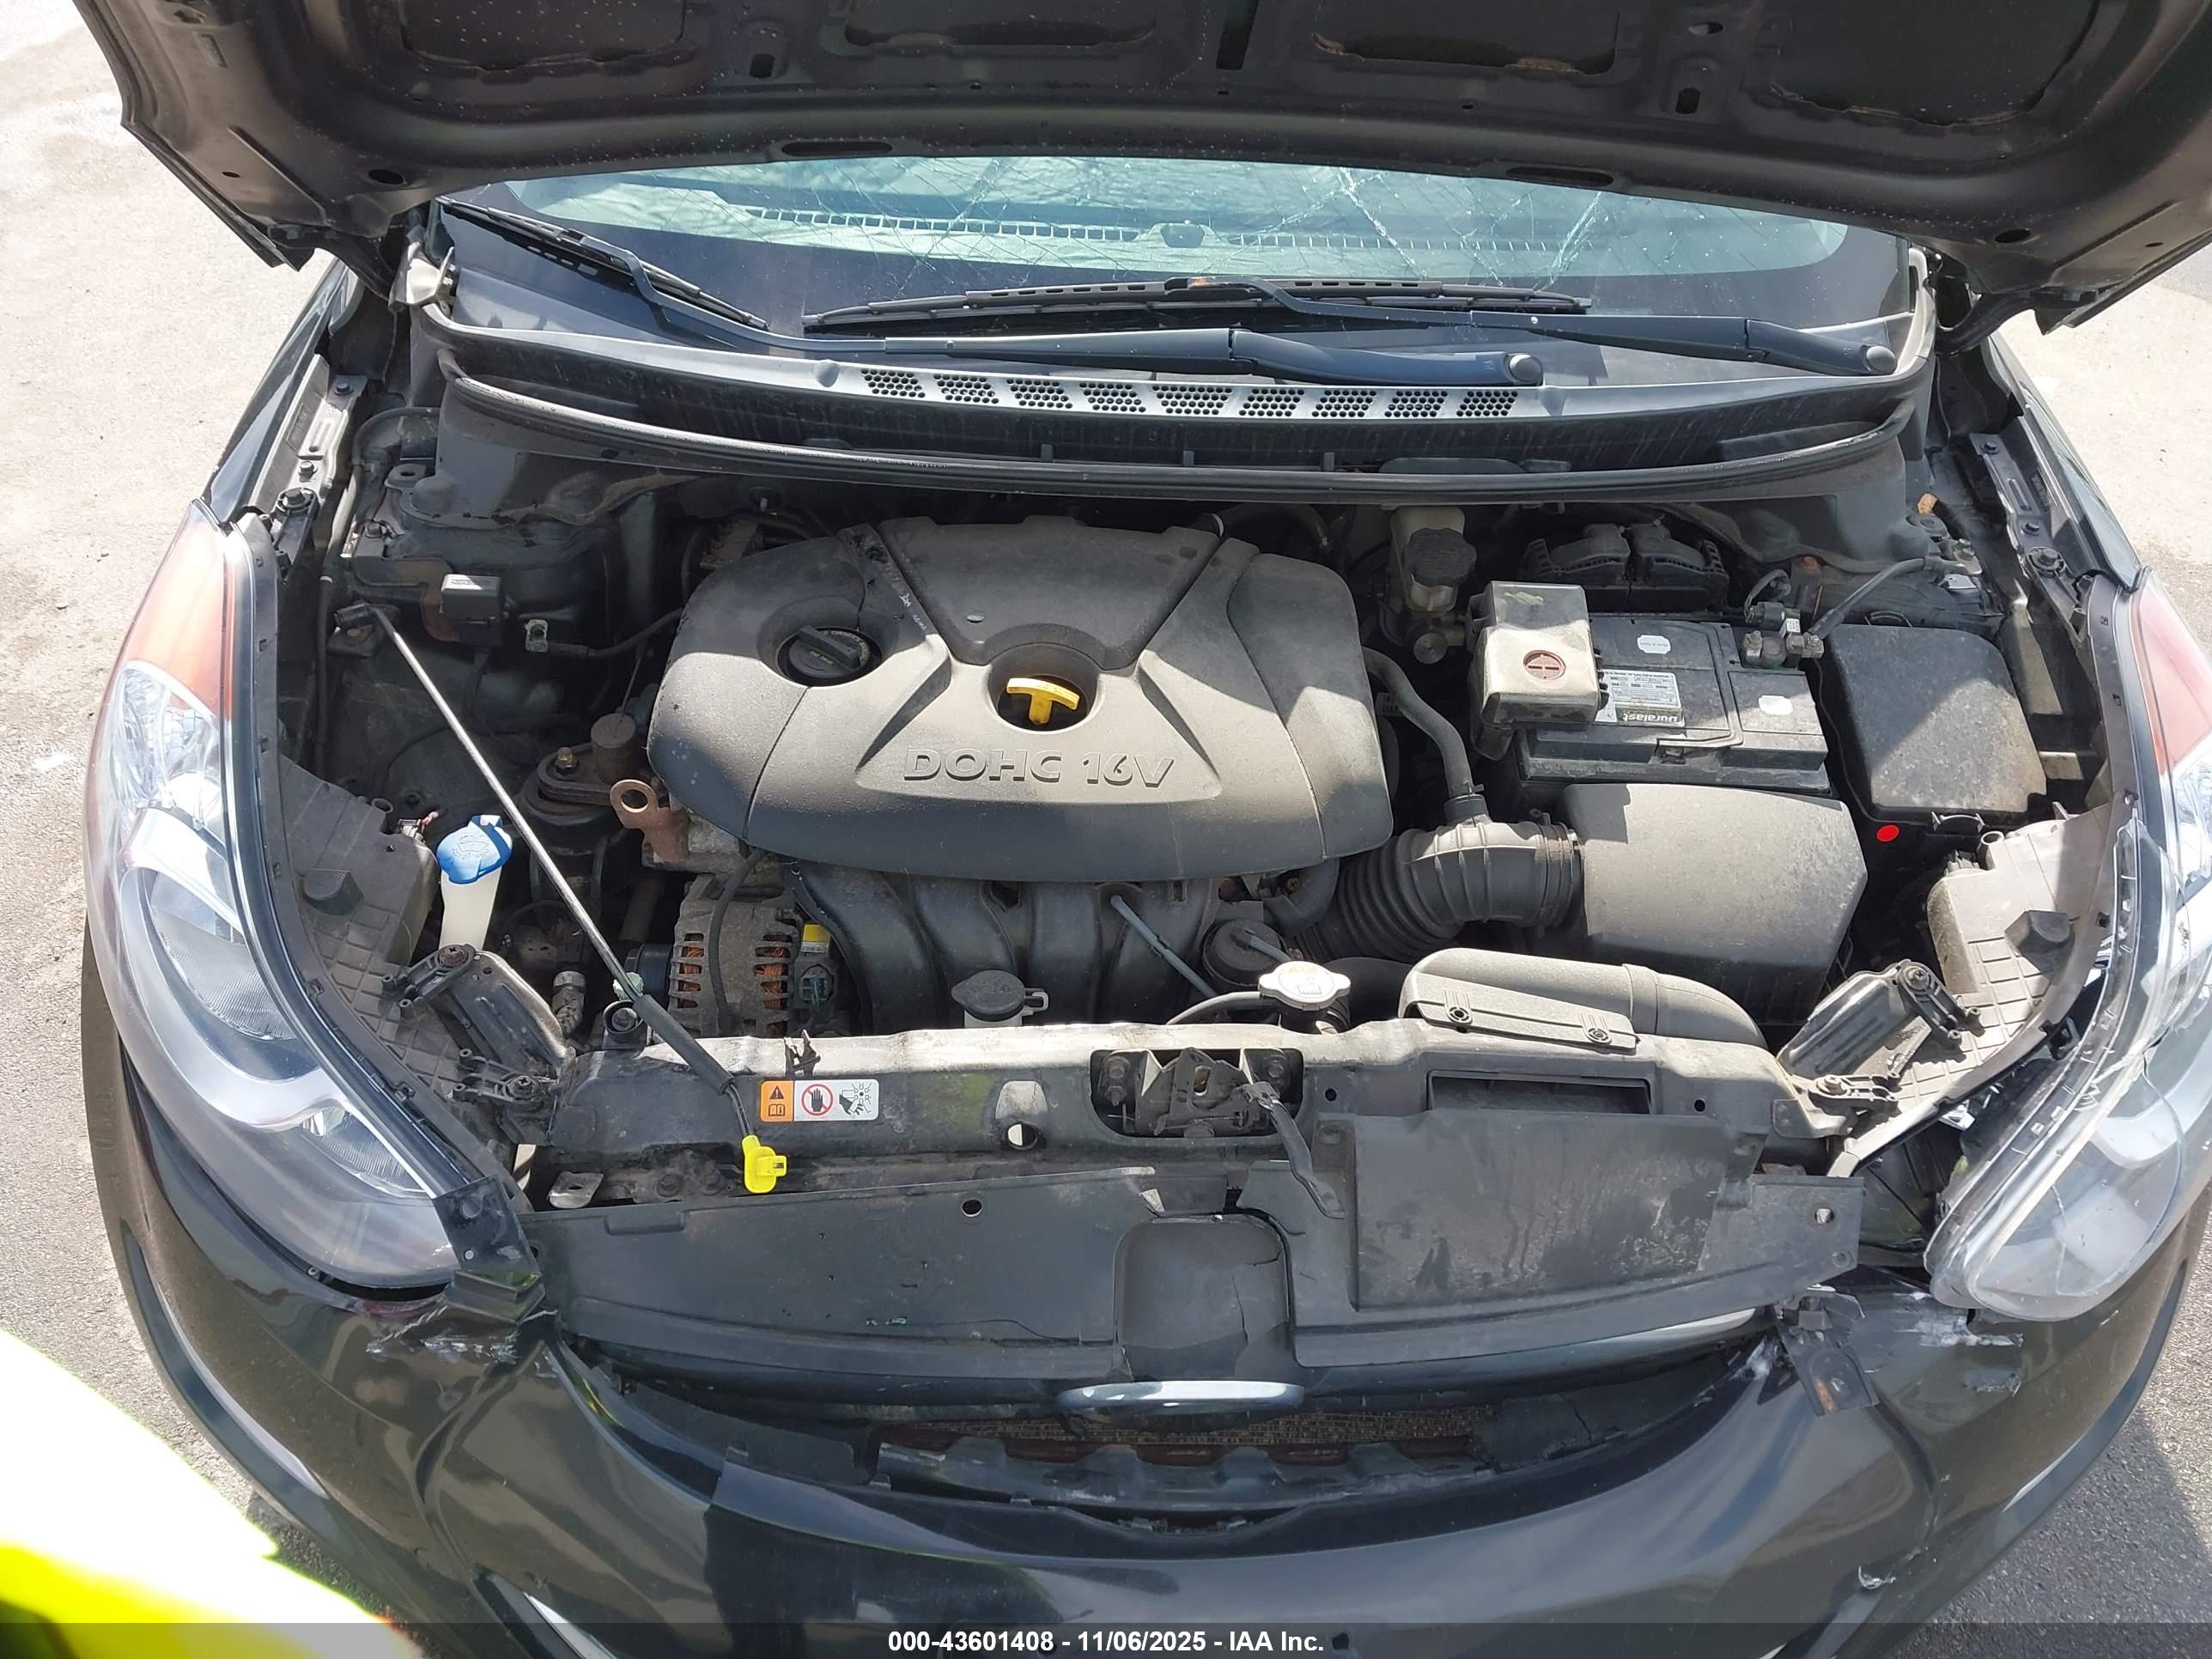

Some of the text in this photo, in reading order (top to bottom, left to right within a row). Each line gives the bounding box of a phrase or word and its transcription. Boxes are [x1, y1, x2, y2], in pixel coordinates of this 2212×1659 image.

[1622, 713, 1678, 722] Duralast
[903, 748, 1174, 788] DOHC 16V
